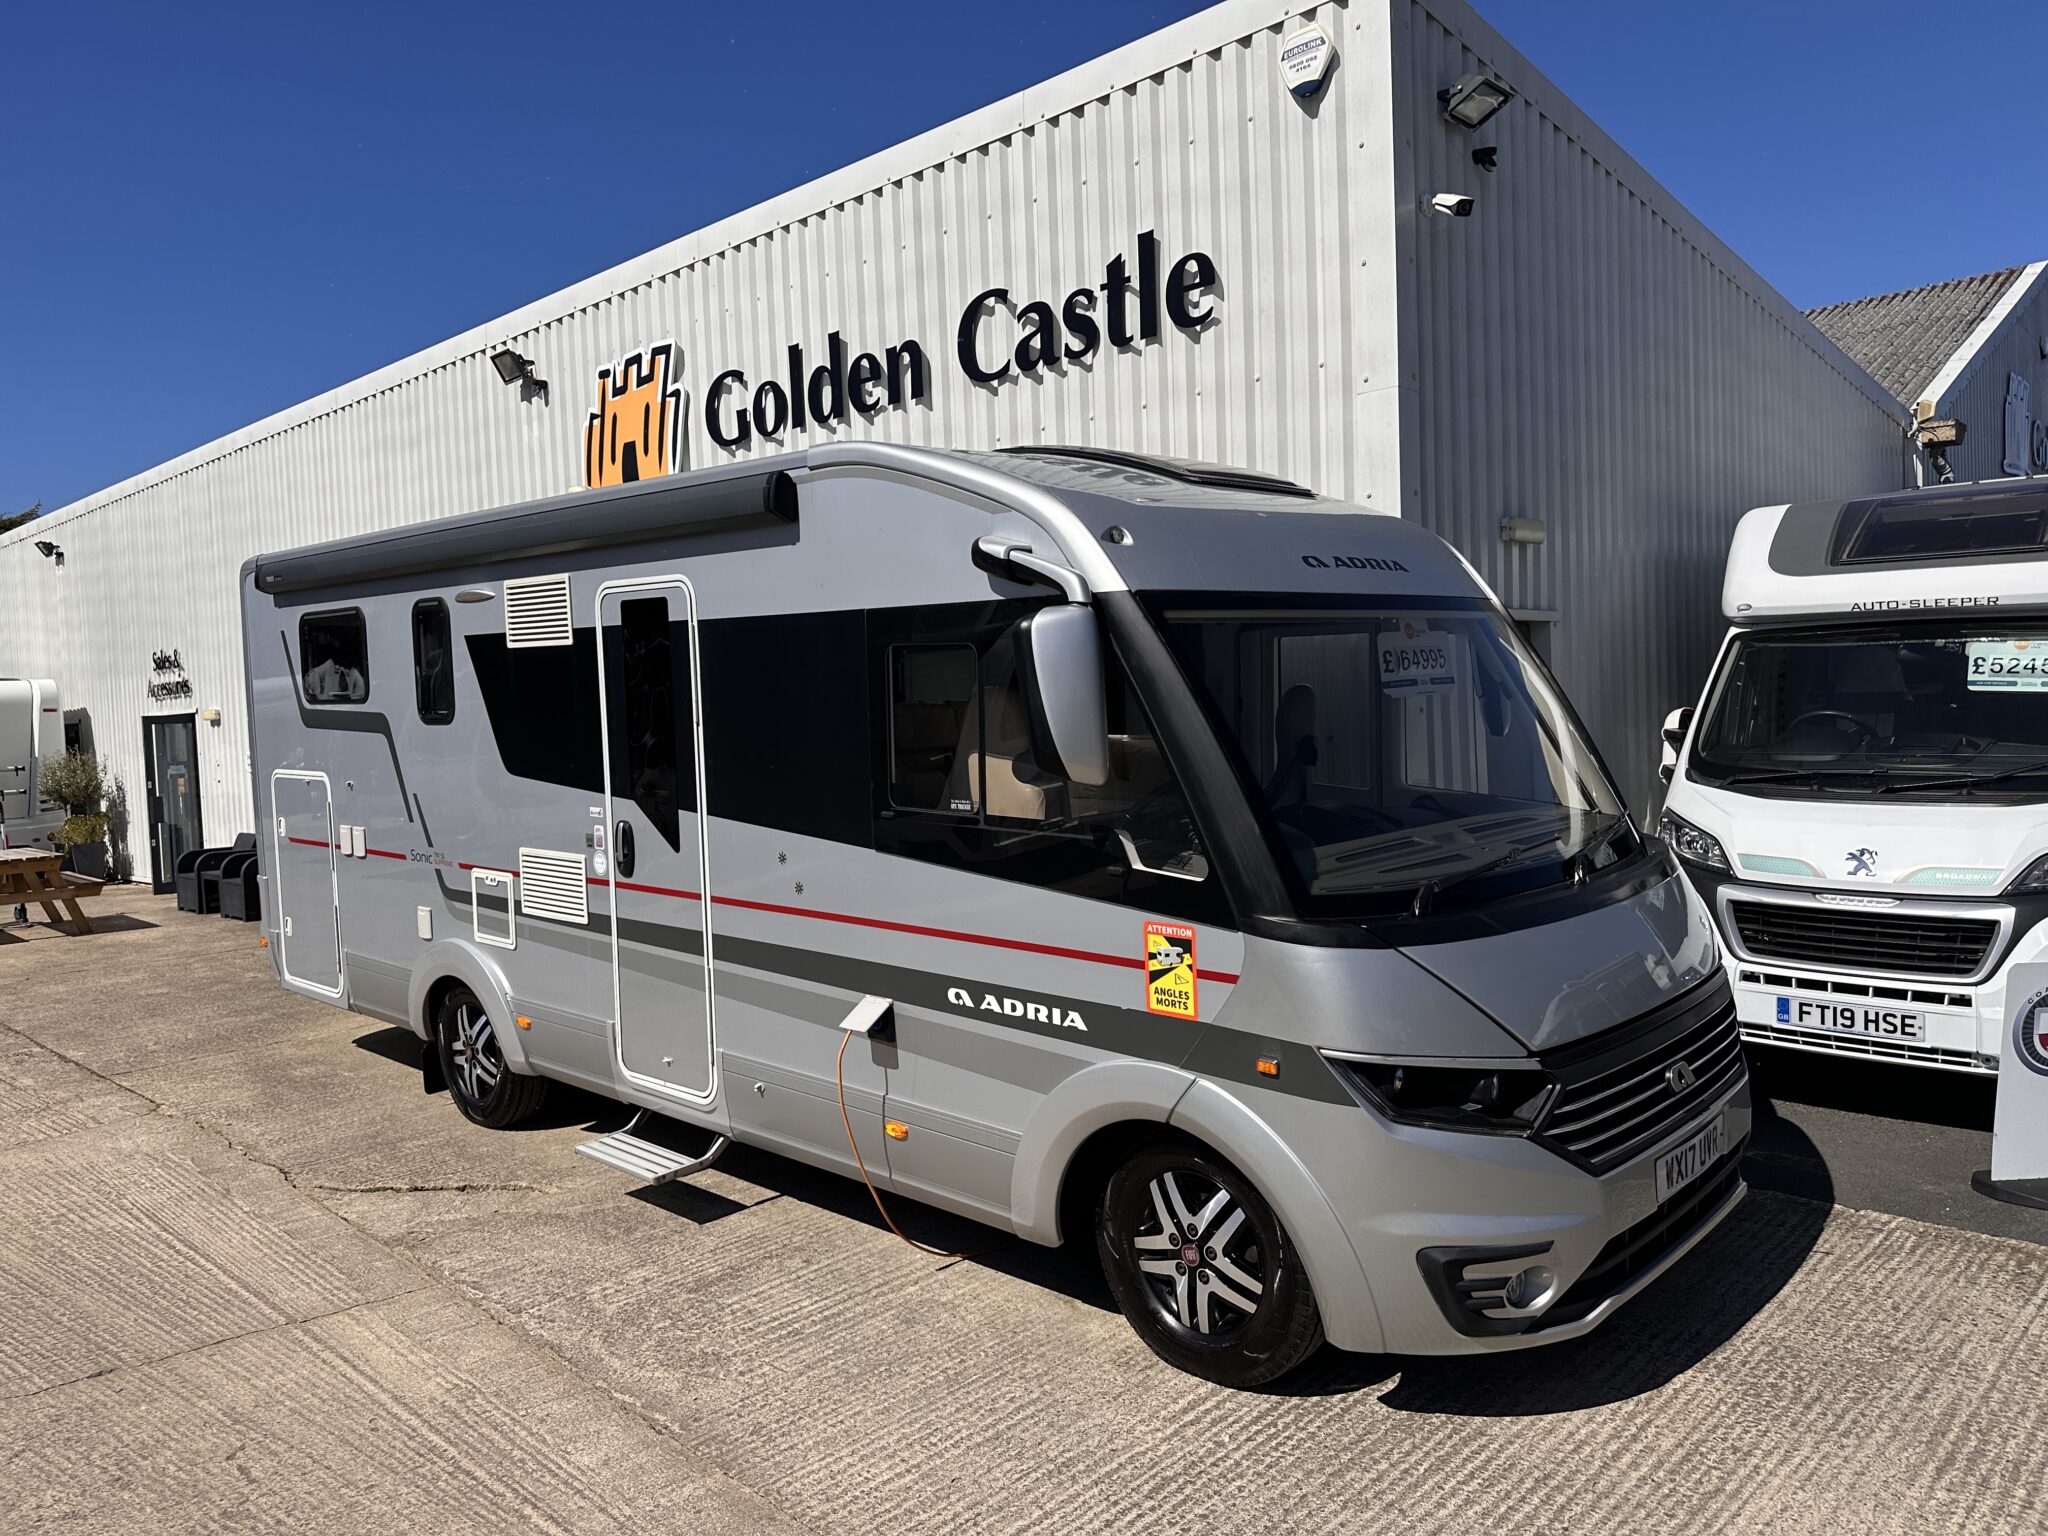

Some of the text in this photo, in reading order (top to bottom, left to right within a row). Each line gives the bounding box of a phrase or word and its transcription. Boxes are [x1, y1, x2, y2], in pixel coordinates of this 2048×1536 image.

[1284, 38, 1323, 59] EUROLINK
[705, 229, 1216, 448] Golden Castle
[1332, 555, 1410, 573] ADRIA
[152, 648, 181, 672] Sales &
[147, 678, 190, 699] Accessories
[410, 848, 433, 865] Sonic
[1146, 923, 1193, 938] ATTENTION
[1154, 986, 1190, 1001] ANGLES
[1156, 997, 1189, 1011] MORTS
[979, 993, 1089, 1032] ADRIA
[1777, 1013, 1789, 1021] GB
[1798, 1001, 1917, 1037] FT19 HSE
[1665, 1124, 1718, 1190] WX17 UVR
